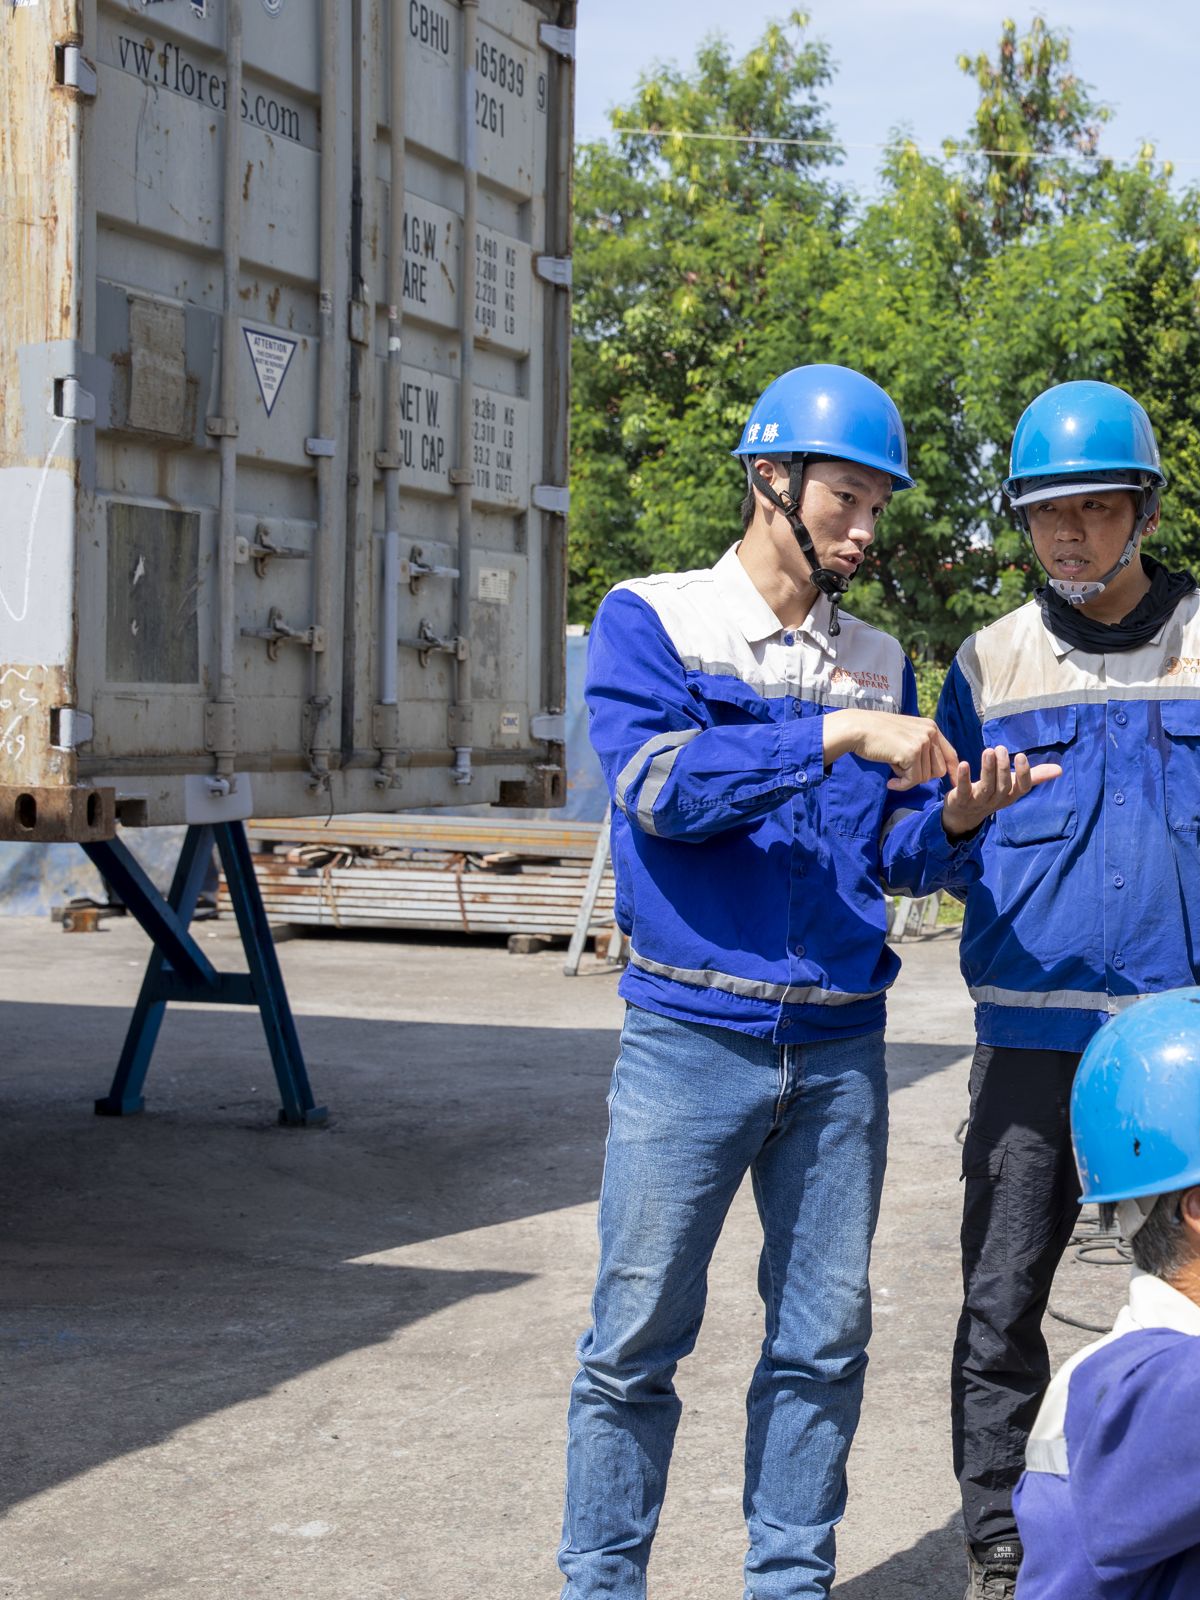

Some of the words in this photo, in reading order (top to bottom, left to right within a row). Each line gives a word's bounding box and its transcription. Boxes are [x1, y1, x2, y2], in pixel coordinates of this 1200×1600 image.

[408, 0, 450, 55] CBHU
[402, 257, 428, 304] ARE
[254, 336, 288, 353] ATTENTION
[425, 388, 440, 429] W.
[747, 422, 780, 444] 偉勝
